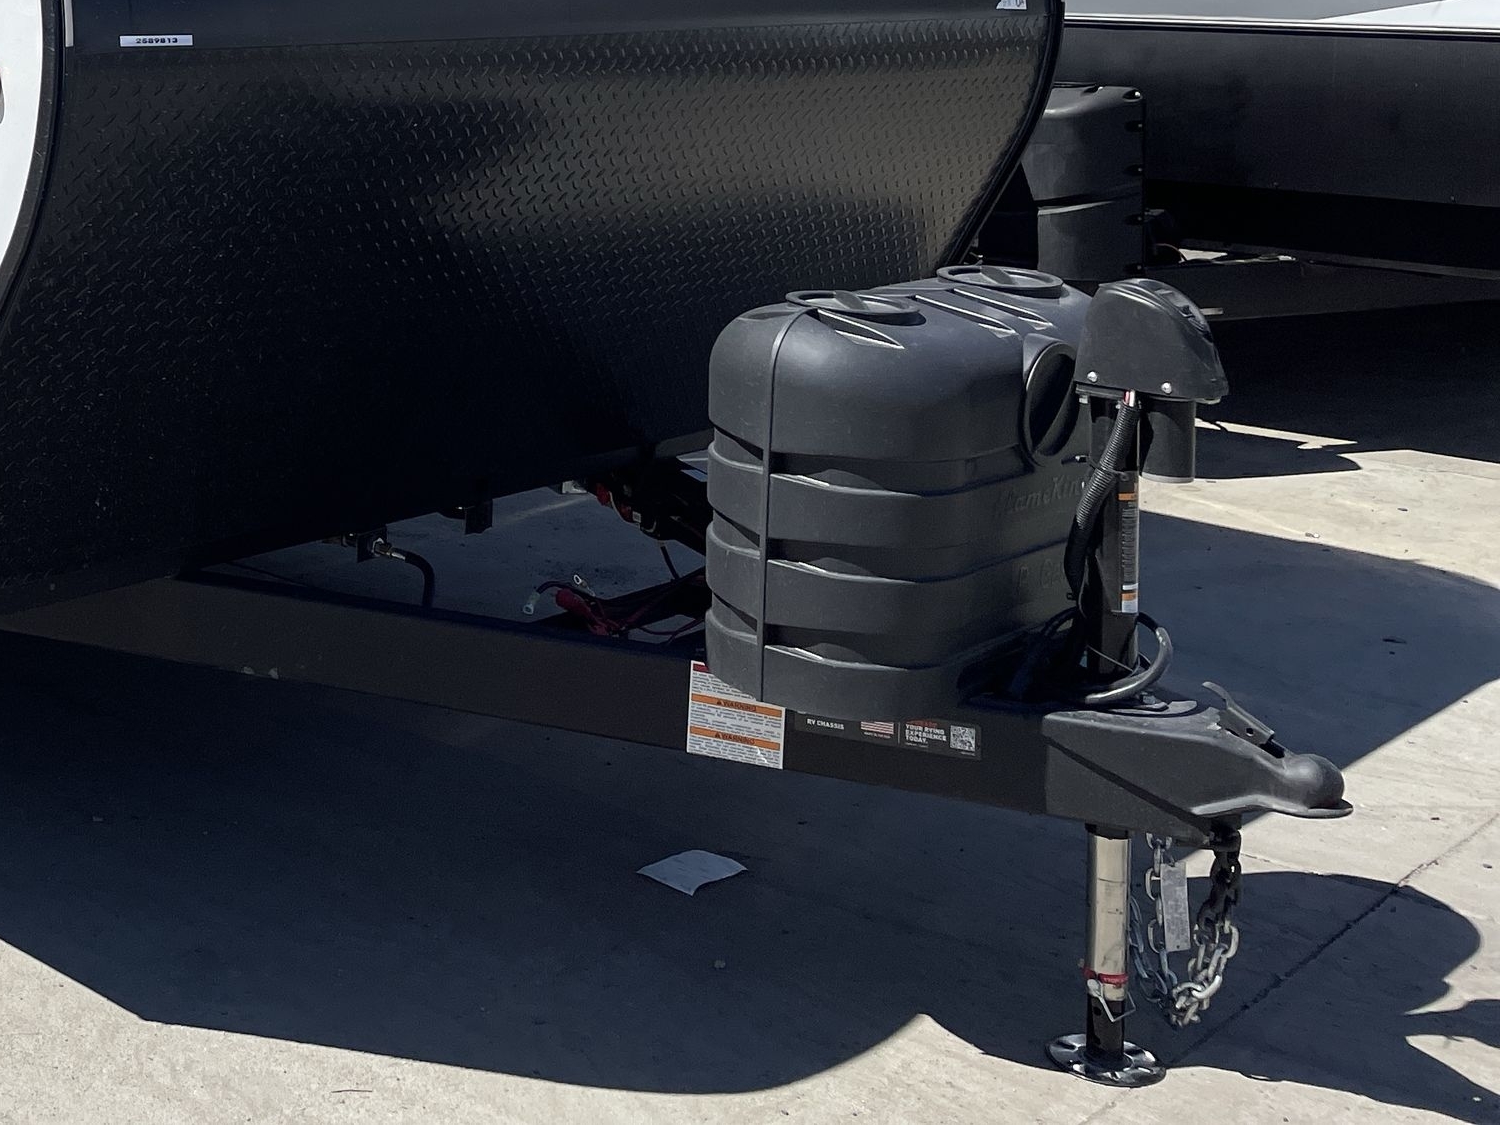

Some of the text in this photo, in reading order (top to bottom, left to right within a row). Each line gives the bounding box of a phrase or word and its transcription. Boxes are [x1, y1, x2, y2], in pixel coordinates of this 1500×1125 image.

[723, 701, 757, 712] WARNING
[816, 720, 845, 730] CHASSIS
[905, 723, 923, 732] YOUR
[721, 733, 756, 745] WARNING
[905, 729, 947, 742] EXPERIENCE
